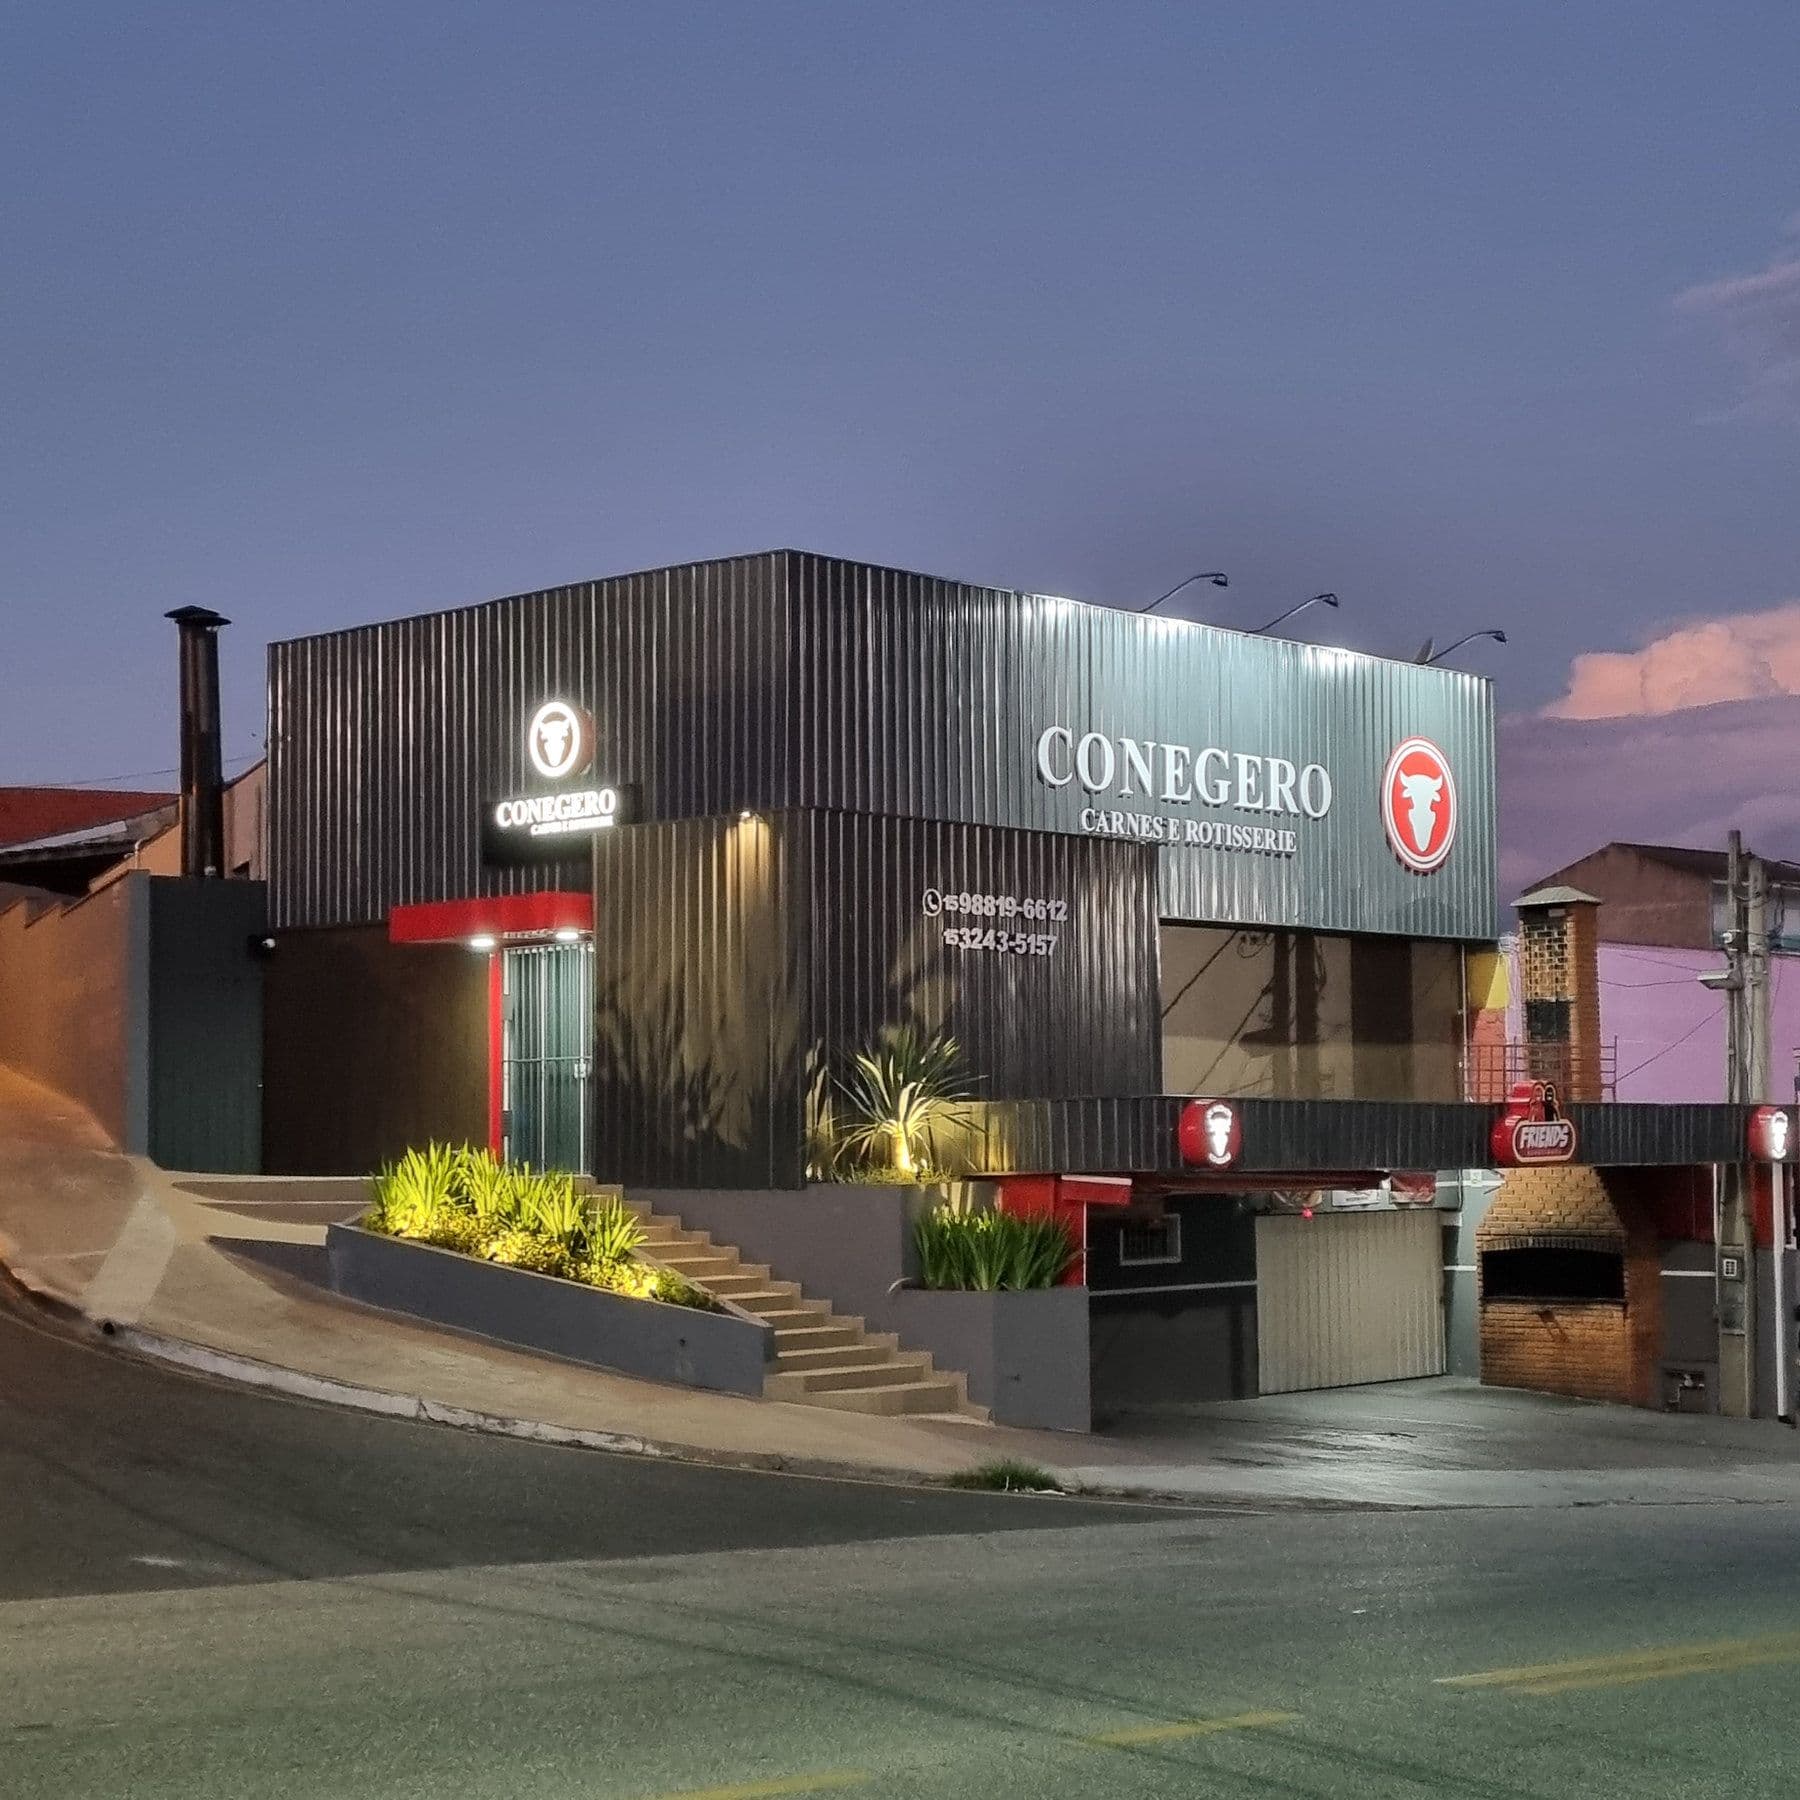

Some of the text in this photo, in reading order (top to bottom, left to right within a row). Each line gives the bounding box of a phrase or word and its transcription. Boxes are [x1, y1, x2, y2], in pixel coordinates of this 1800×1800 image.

[1037, 726, 1332, 818] CONEGERO
[497, 788, 616, 827] CONEGERO
[1081, 808, 1297, 852] CARNES E ROTISSERIE
[1519, 1125, 1569, 1149] FRIENDS
